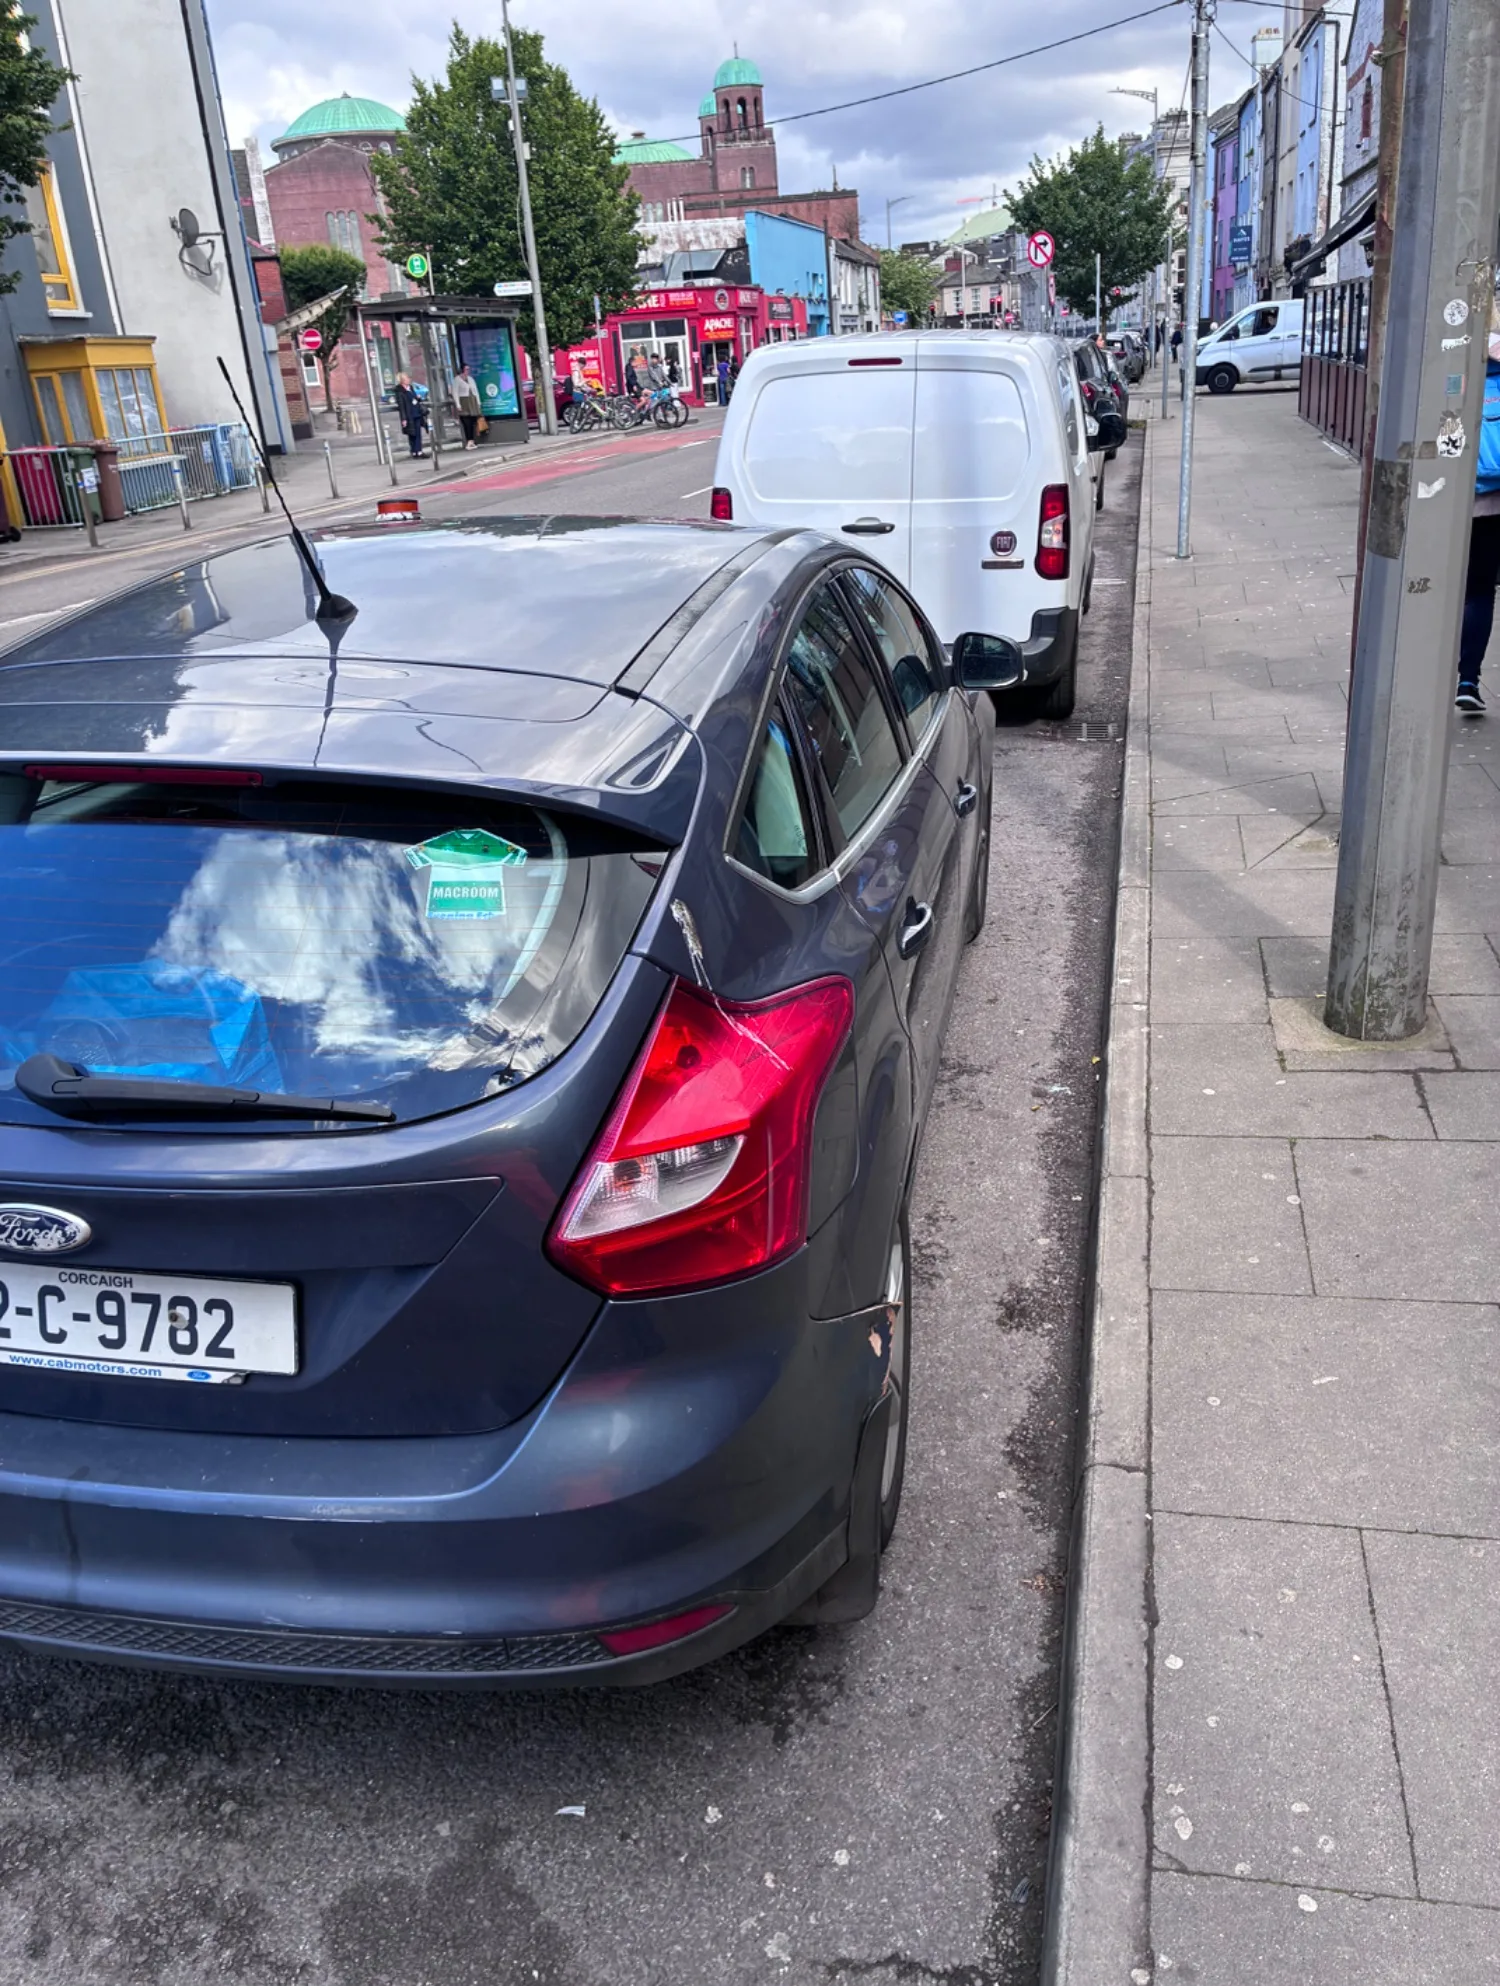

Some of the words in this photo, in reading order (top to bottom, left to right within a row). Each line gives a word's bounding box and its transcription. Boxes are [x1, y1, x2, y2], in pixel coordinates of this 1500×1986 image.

[996, 536, 1012, 549] FIAT
[433, 886, 499, 899] MACROOM
[58, 1271, 134, 1289] CORCAIGH
[9, 1354, 162, 1377] www.cabmotors.com
